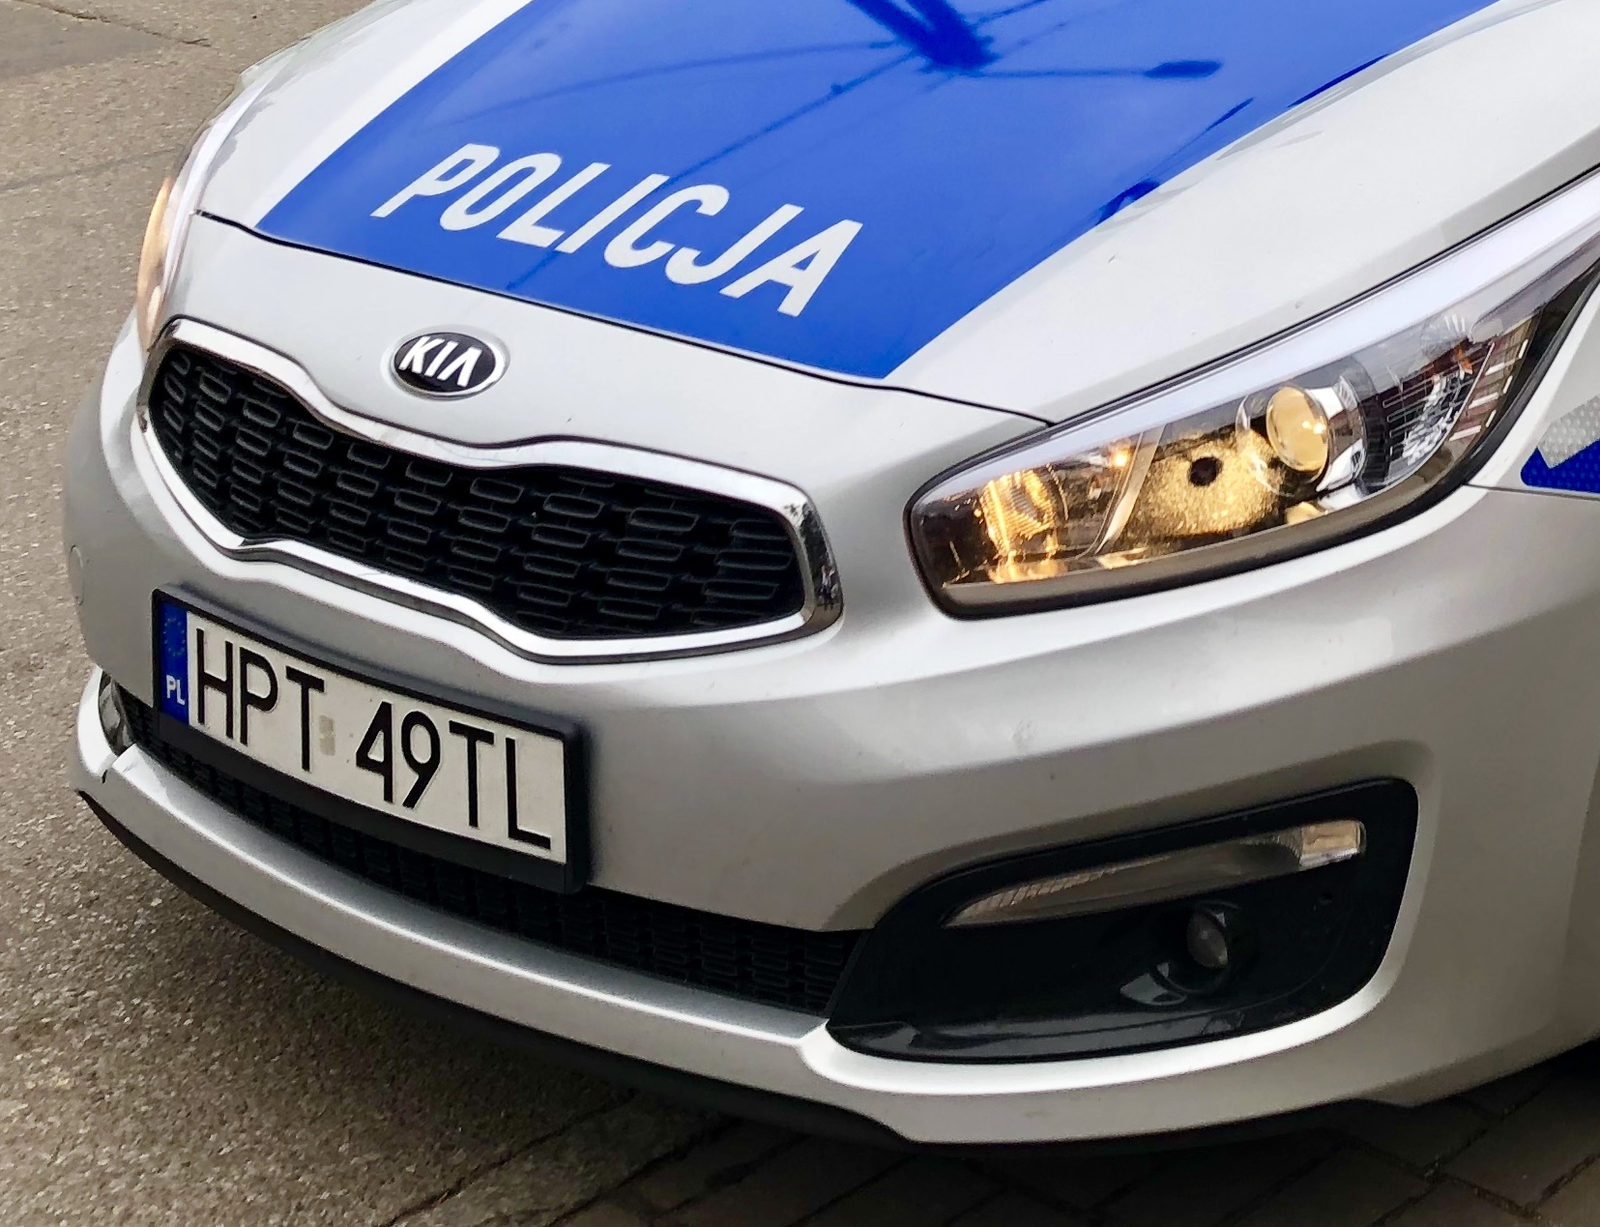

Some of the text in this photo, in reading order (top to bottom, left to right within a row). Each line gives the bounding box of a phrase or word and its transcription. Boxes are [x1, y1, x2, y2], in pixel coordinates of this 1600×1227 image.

[370, 143, 864, 317] POLICJA
[398, 336, 482, 387] KIA
[165, 674, 186, 707] PL
[196, 628, 552, 851] HPT 49TL
